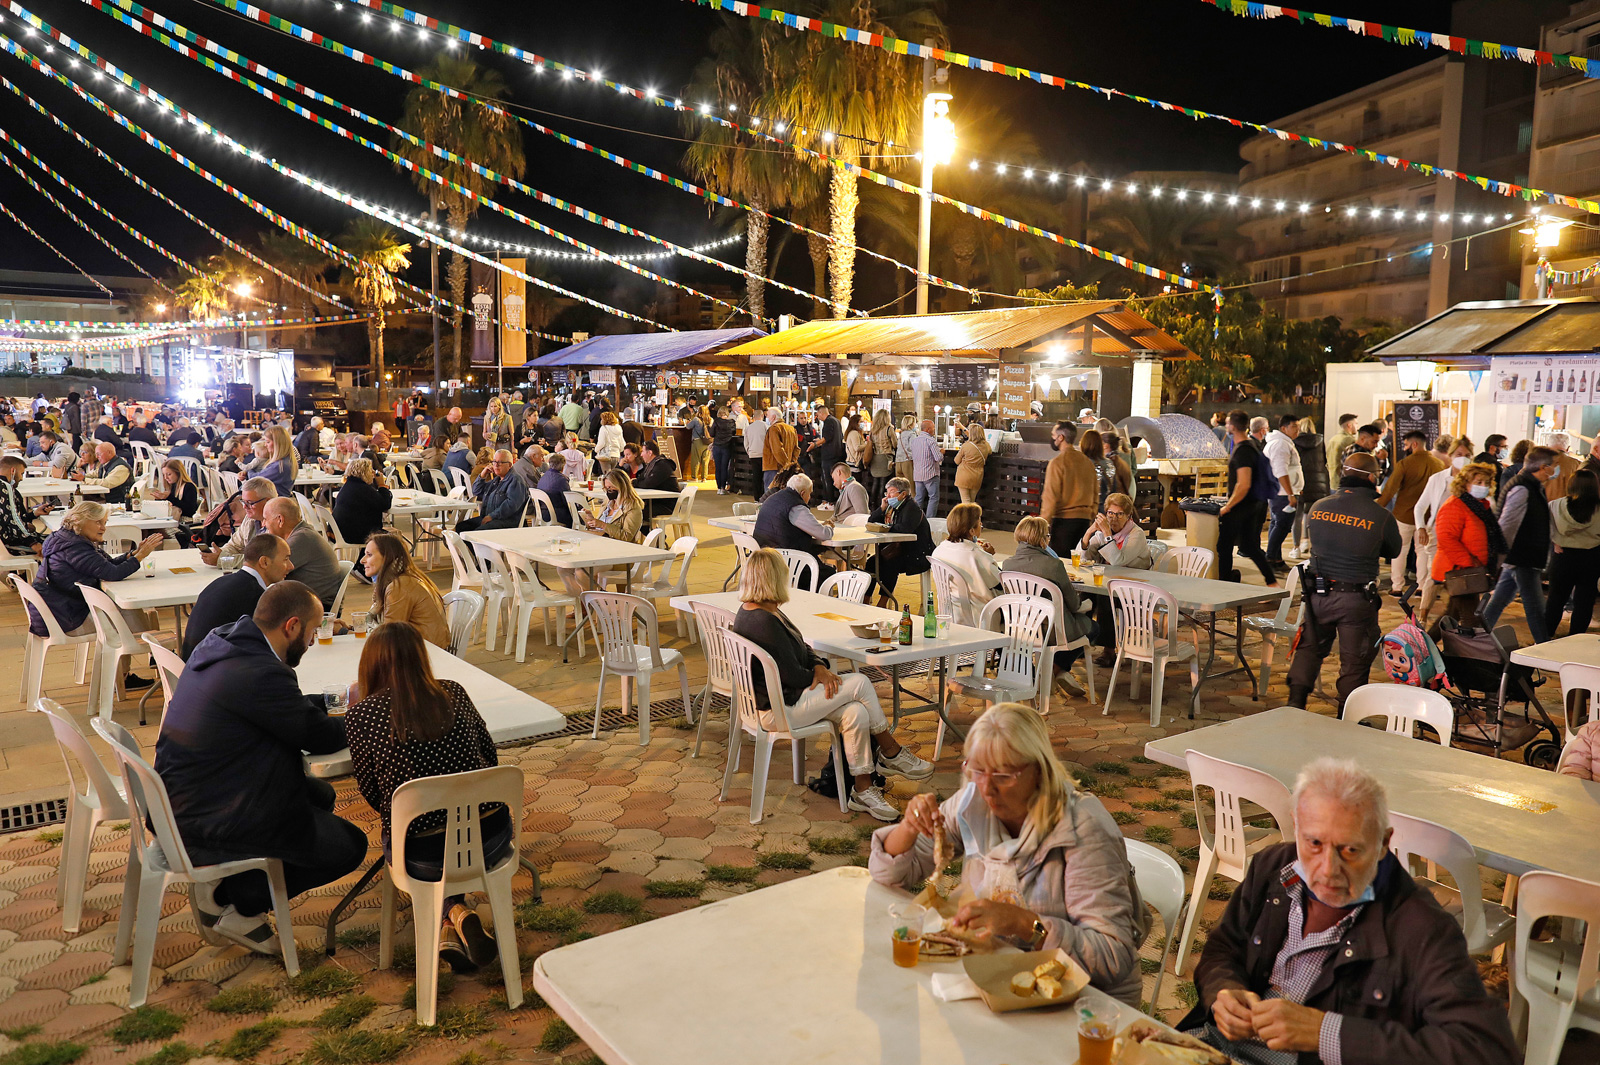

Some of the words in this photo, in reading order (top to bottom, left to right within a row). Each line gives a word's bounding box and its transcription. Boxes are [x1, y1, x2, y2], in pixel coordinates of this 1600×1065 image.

[1004, 365, 1025, 374] Pizzes
[1002, 378, 1026, 388] Burgers
[1003, 392, 1024, 403] Tapes
[1002, 406, 1026, 417] Patates
[1311, 510, 1375, 531] SEGURETAT
